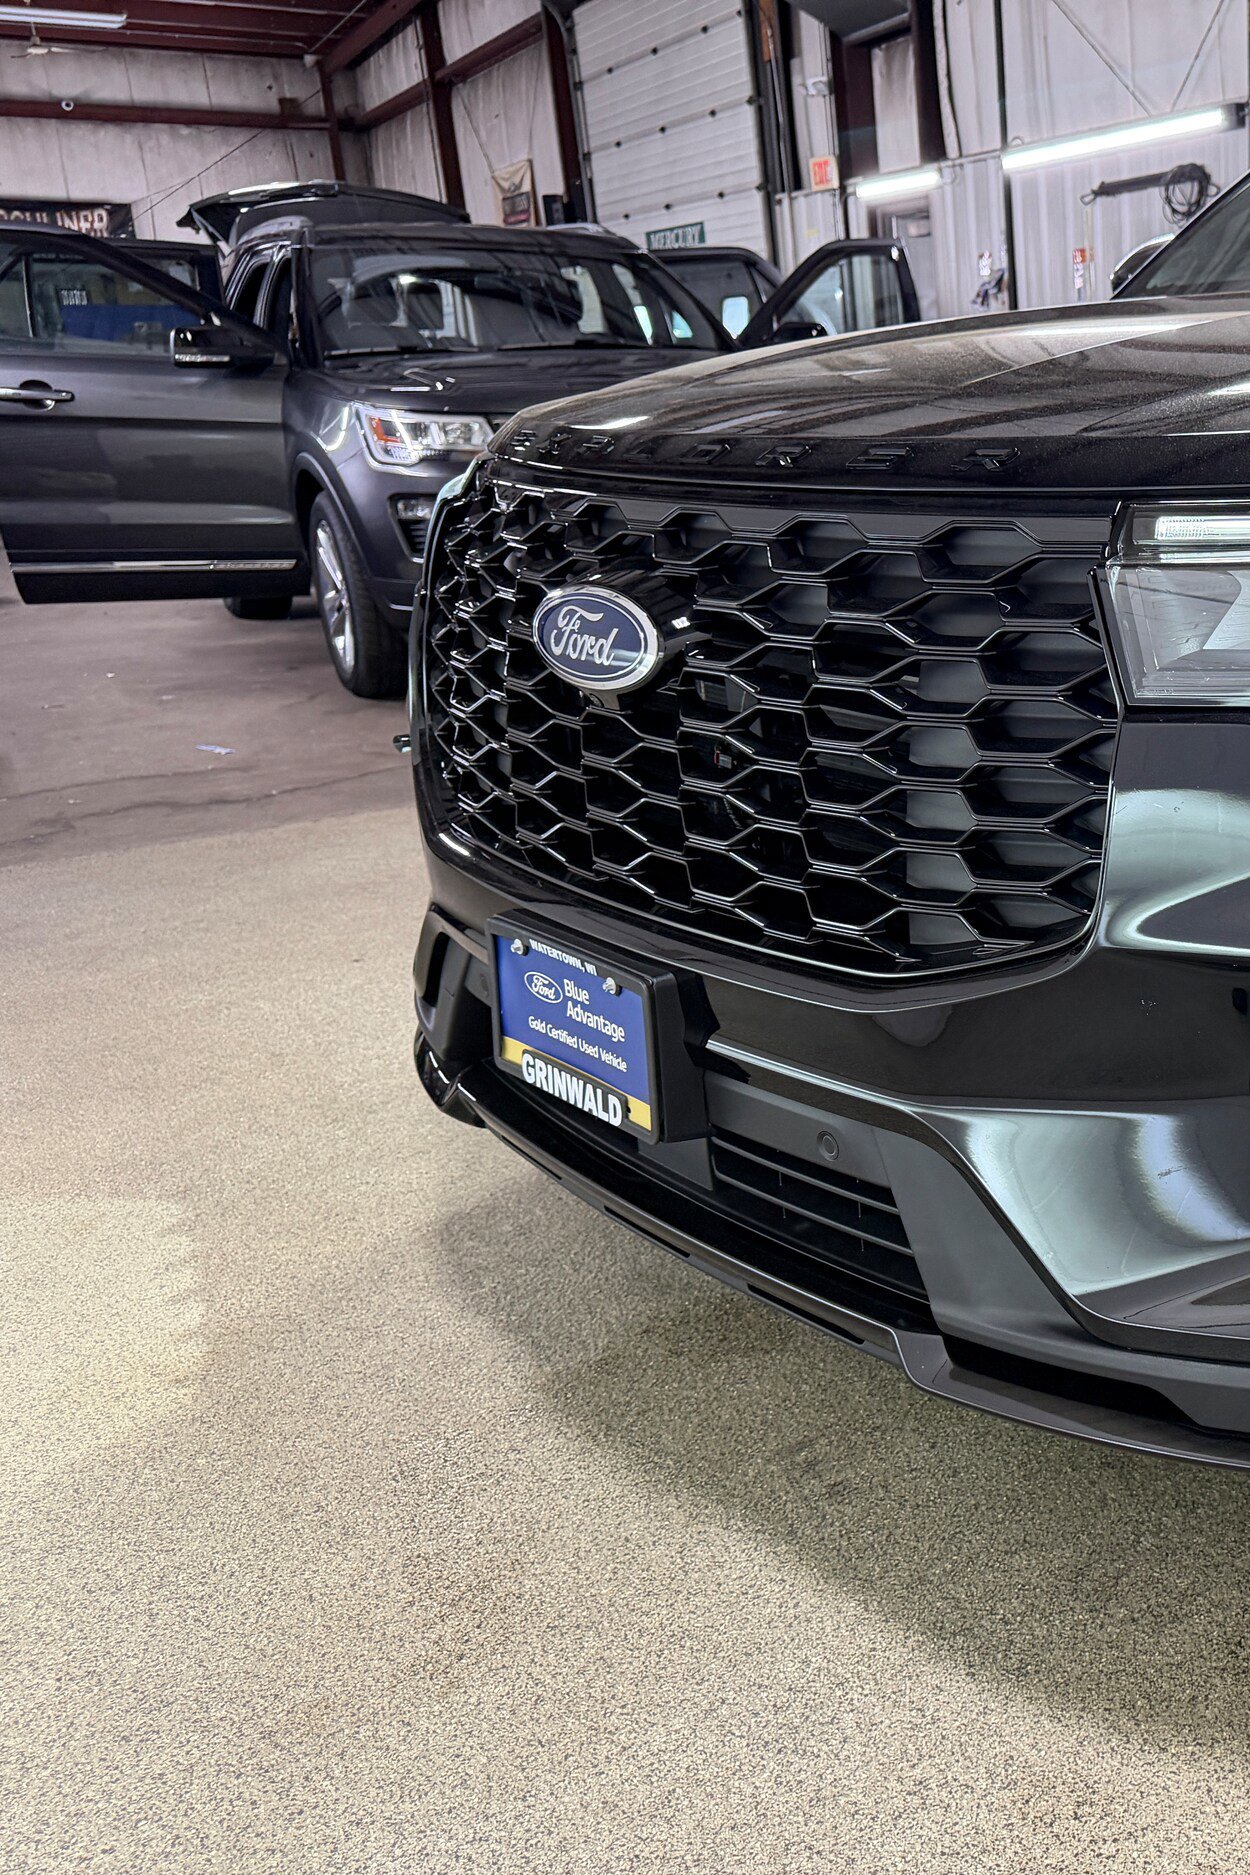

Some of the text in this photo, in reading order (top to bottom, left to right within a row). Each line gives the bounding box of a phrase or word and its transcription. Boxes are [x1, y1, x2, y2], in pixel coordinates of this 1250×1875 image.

[549, 604, 620, 667] Ford
[529, 938, 598, 976] WATERTOWN, WI
[531, 974, 556, 1000] Ford
[563, 978, 590, 1005] Blue
[566, 1000, 626, 1042] Advantage
[528, 1015, 628, 1073] Gold Certified Used Vehicle
[520, 1052, 624, 1128] GRINWALD
